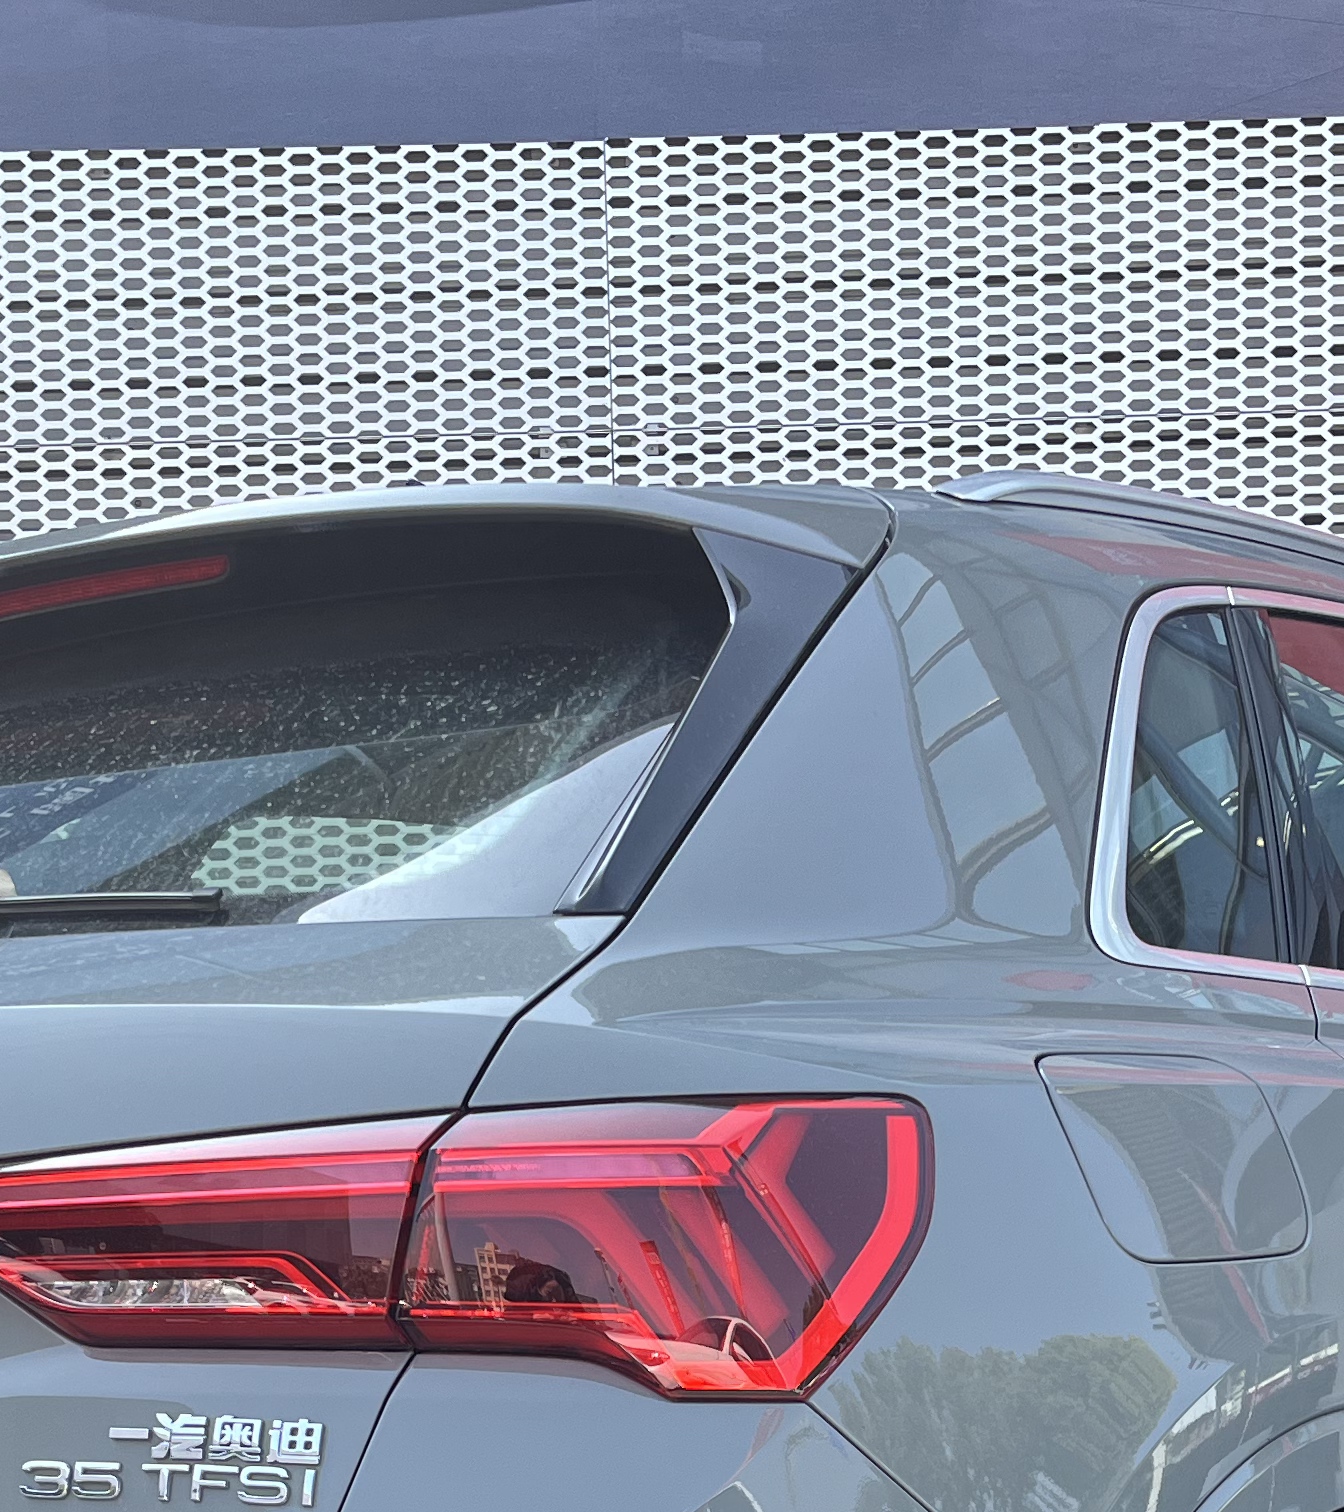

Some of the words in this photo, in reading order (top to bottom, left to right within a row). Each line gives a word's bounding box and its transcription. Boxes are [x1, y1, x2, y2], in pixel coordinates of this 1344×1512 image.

[109, 1412, 325, 1465] 一汽奥迪
[18, 1460, 122, 1499] 35
[141, 1463, 318, 1507] TFSI
